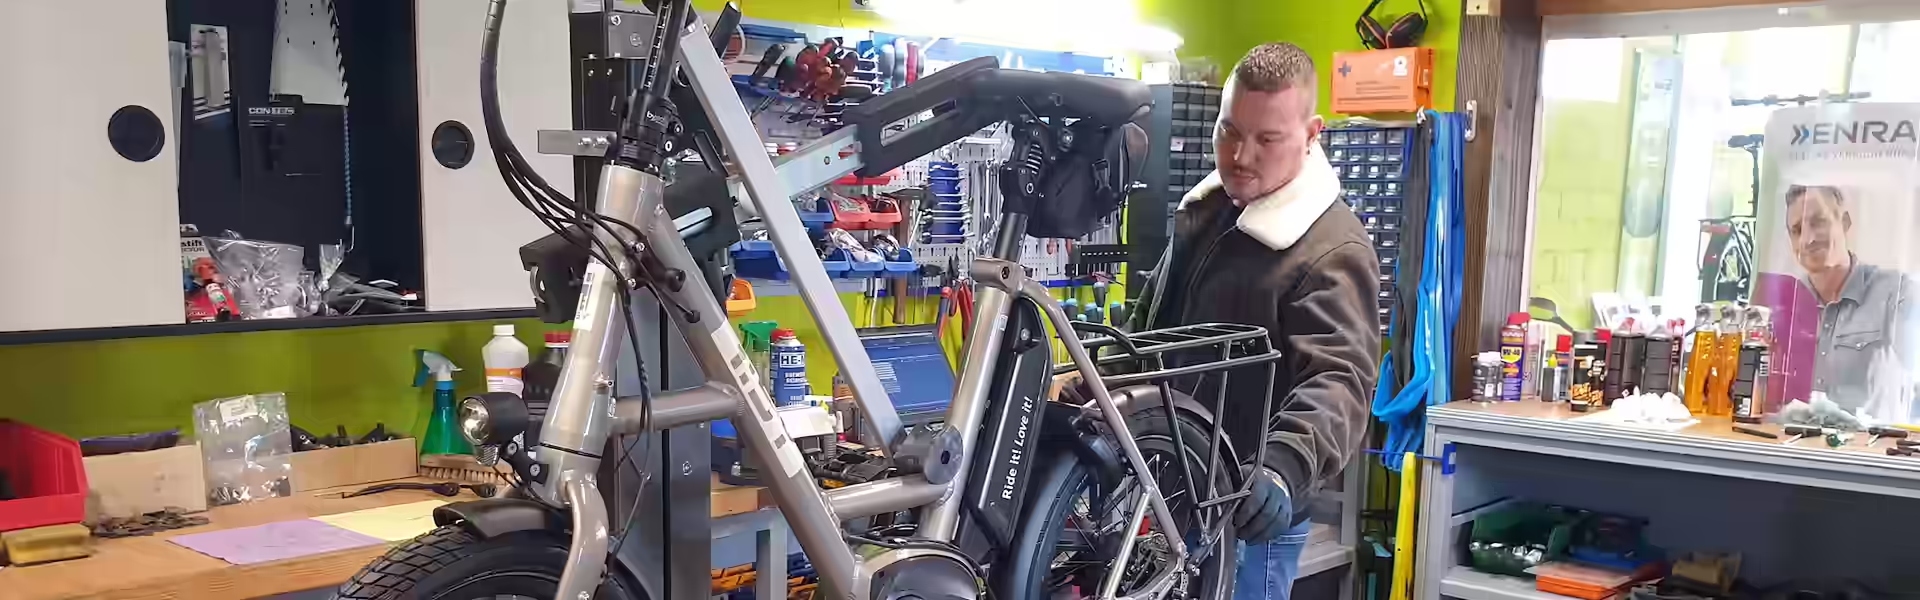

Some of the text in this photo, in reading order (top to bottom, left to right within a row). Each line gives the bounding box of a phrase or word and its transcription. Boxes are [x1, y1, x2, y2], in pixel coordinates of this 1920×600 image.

[1812, 119, 1917, 144] ENRA
[1021, 396, 1033, 413] it!
[1014, 415, 1029, 447] Love
[1002, 468, 1018, 500] Ride
